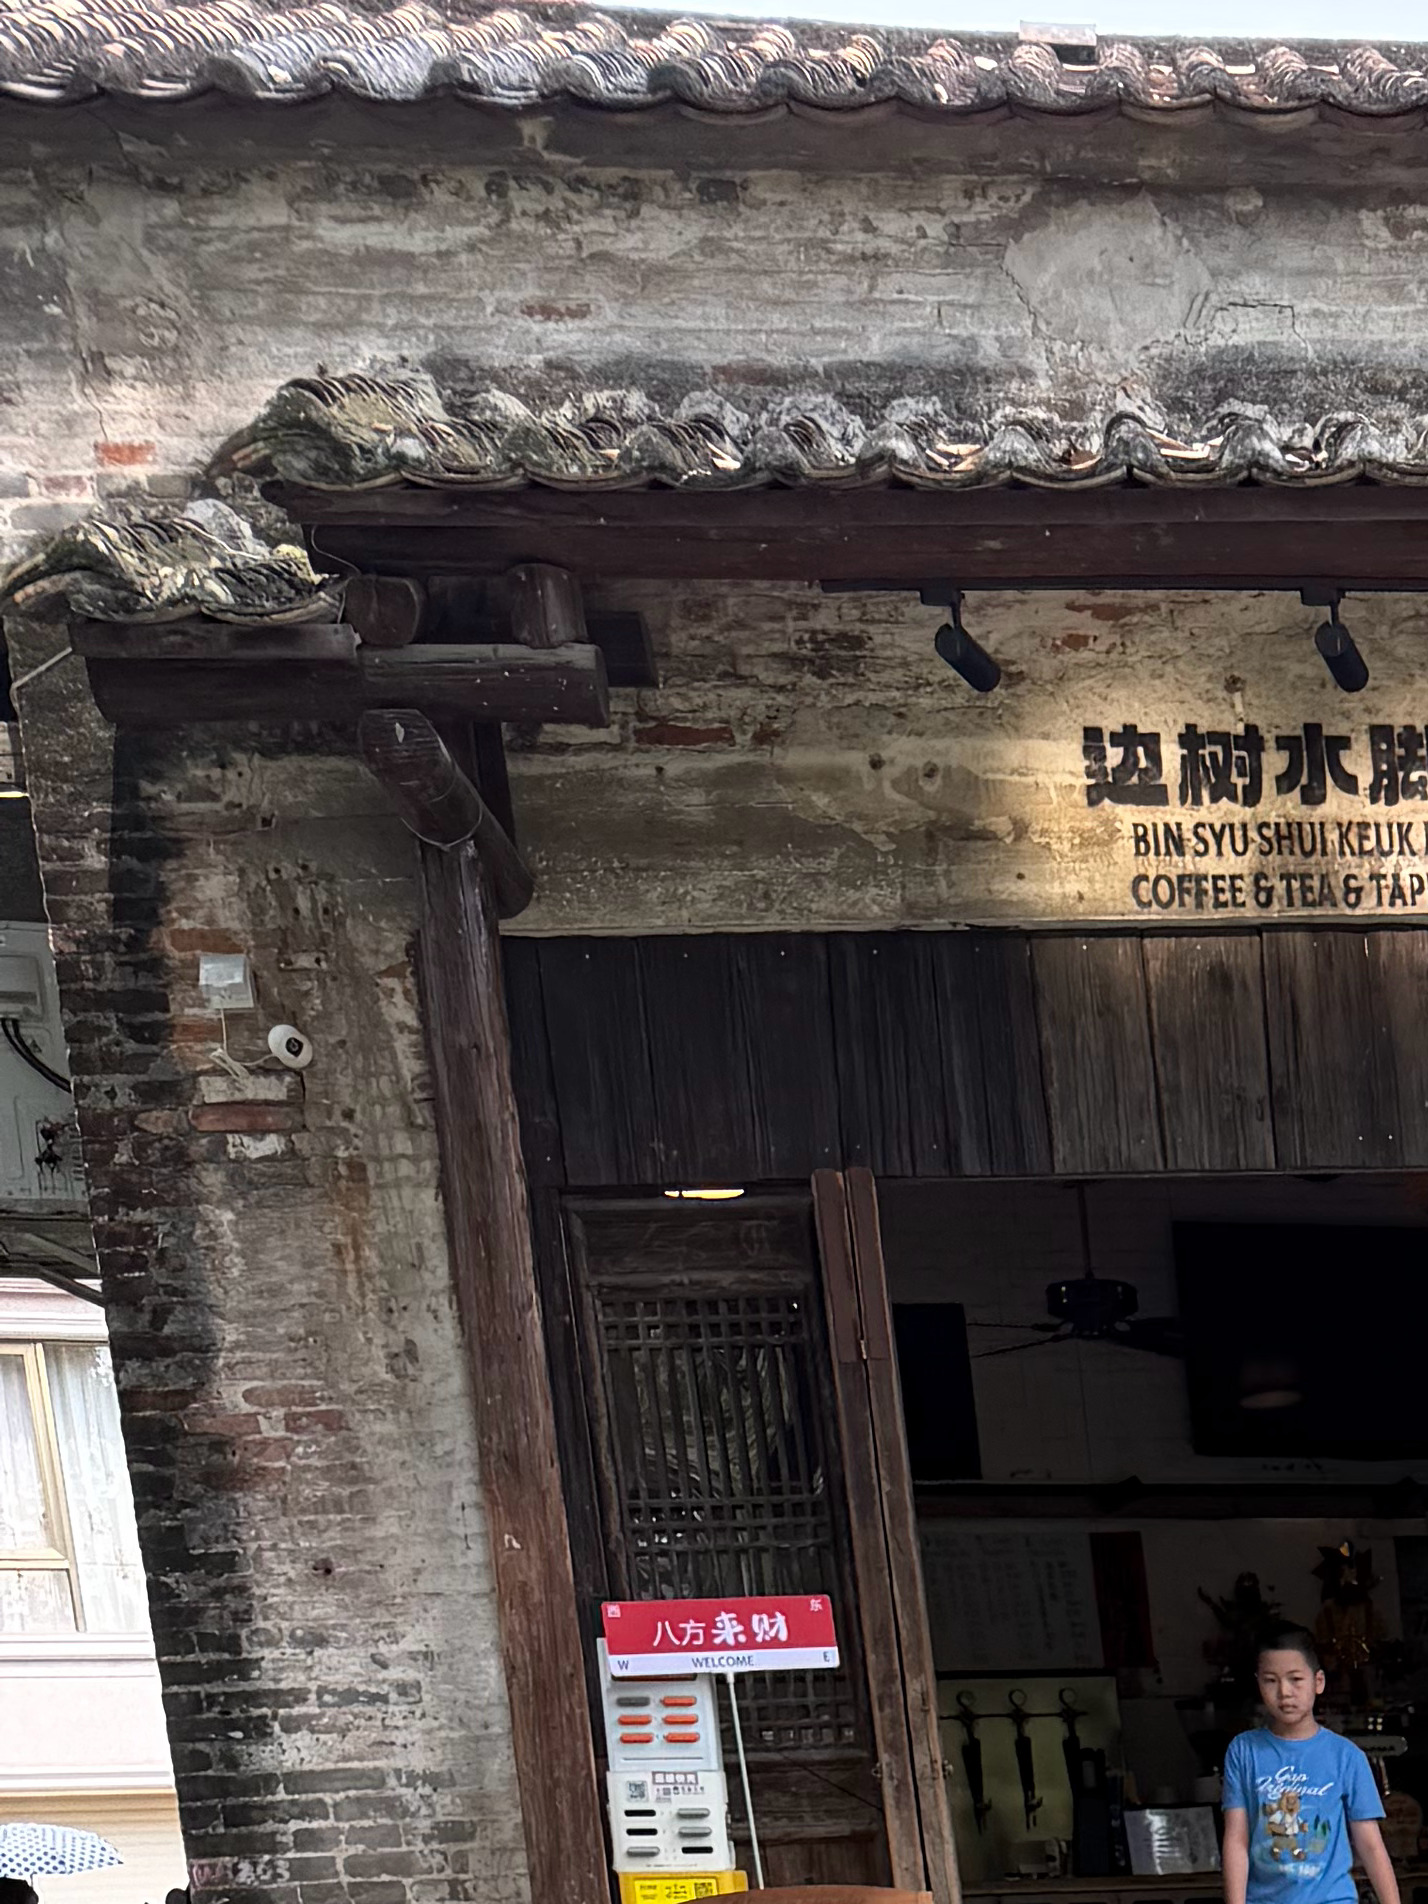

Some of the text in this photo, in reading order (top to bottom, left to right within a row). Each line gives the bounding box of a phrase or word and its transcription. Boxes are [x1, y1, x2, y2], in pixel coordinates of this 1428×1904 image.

[1132, 822, 1184, 858] BIN
[1193, 822, 1249, 858] SYU
[1259, 822, 1327, 858] SHUI
[1338, 821, 1415, 858] KEUK
[1132, 873, 1244, 910] COFFEE
[1254, 873, 1274, 907] &
[1280, 873, 1336, 907] TEA
[1344, 873, 1365, 907] &
[653, 1611, 788, 1646] 八方来财
[617, 1651, 831, 1670] W WELCOME E
